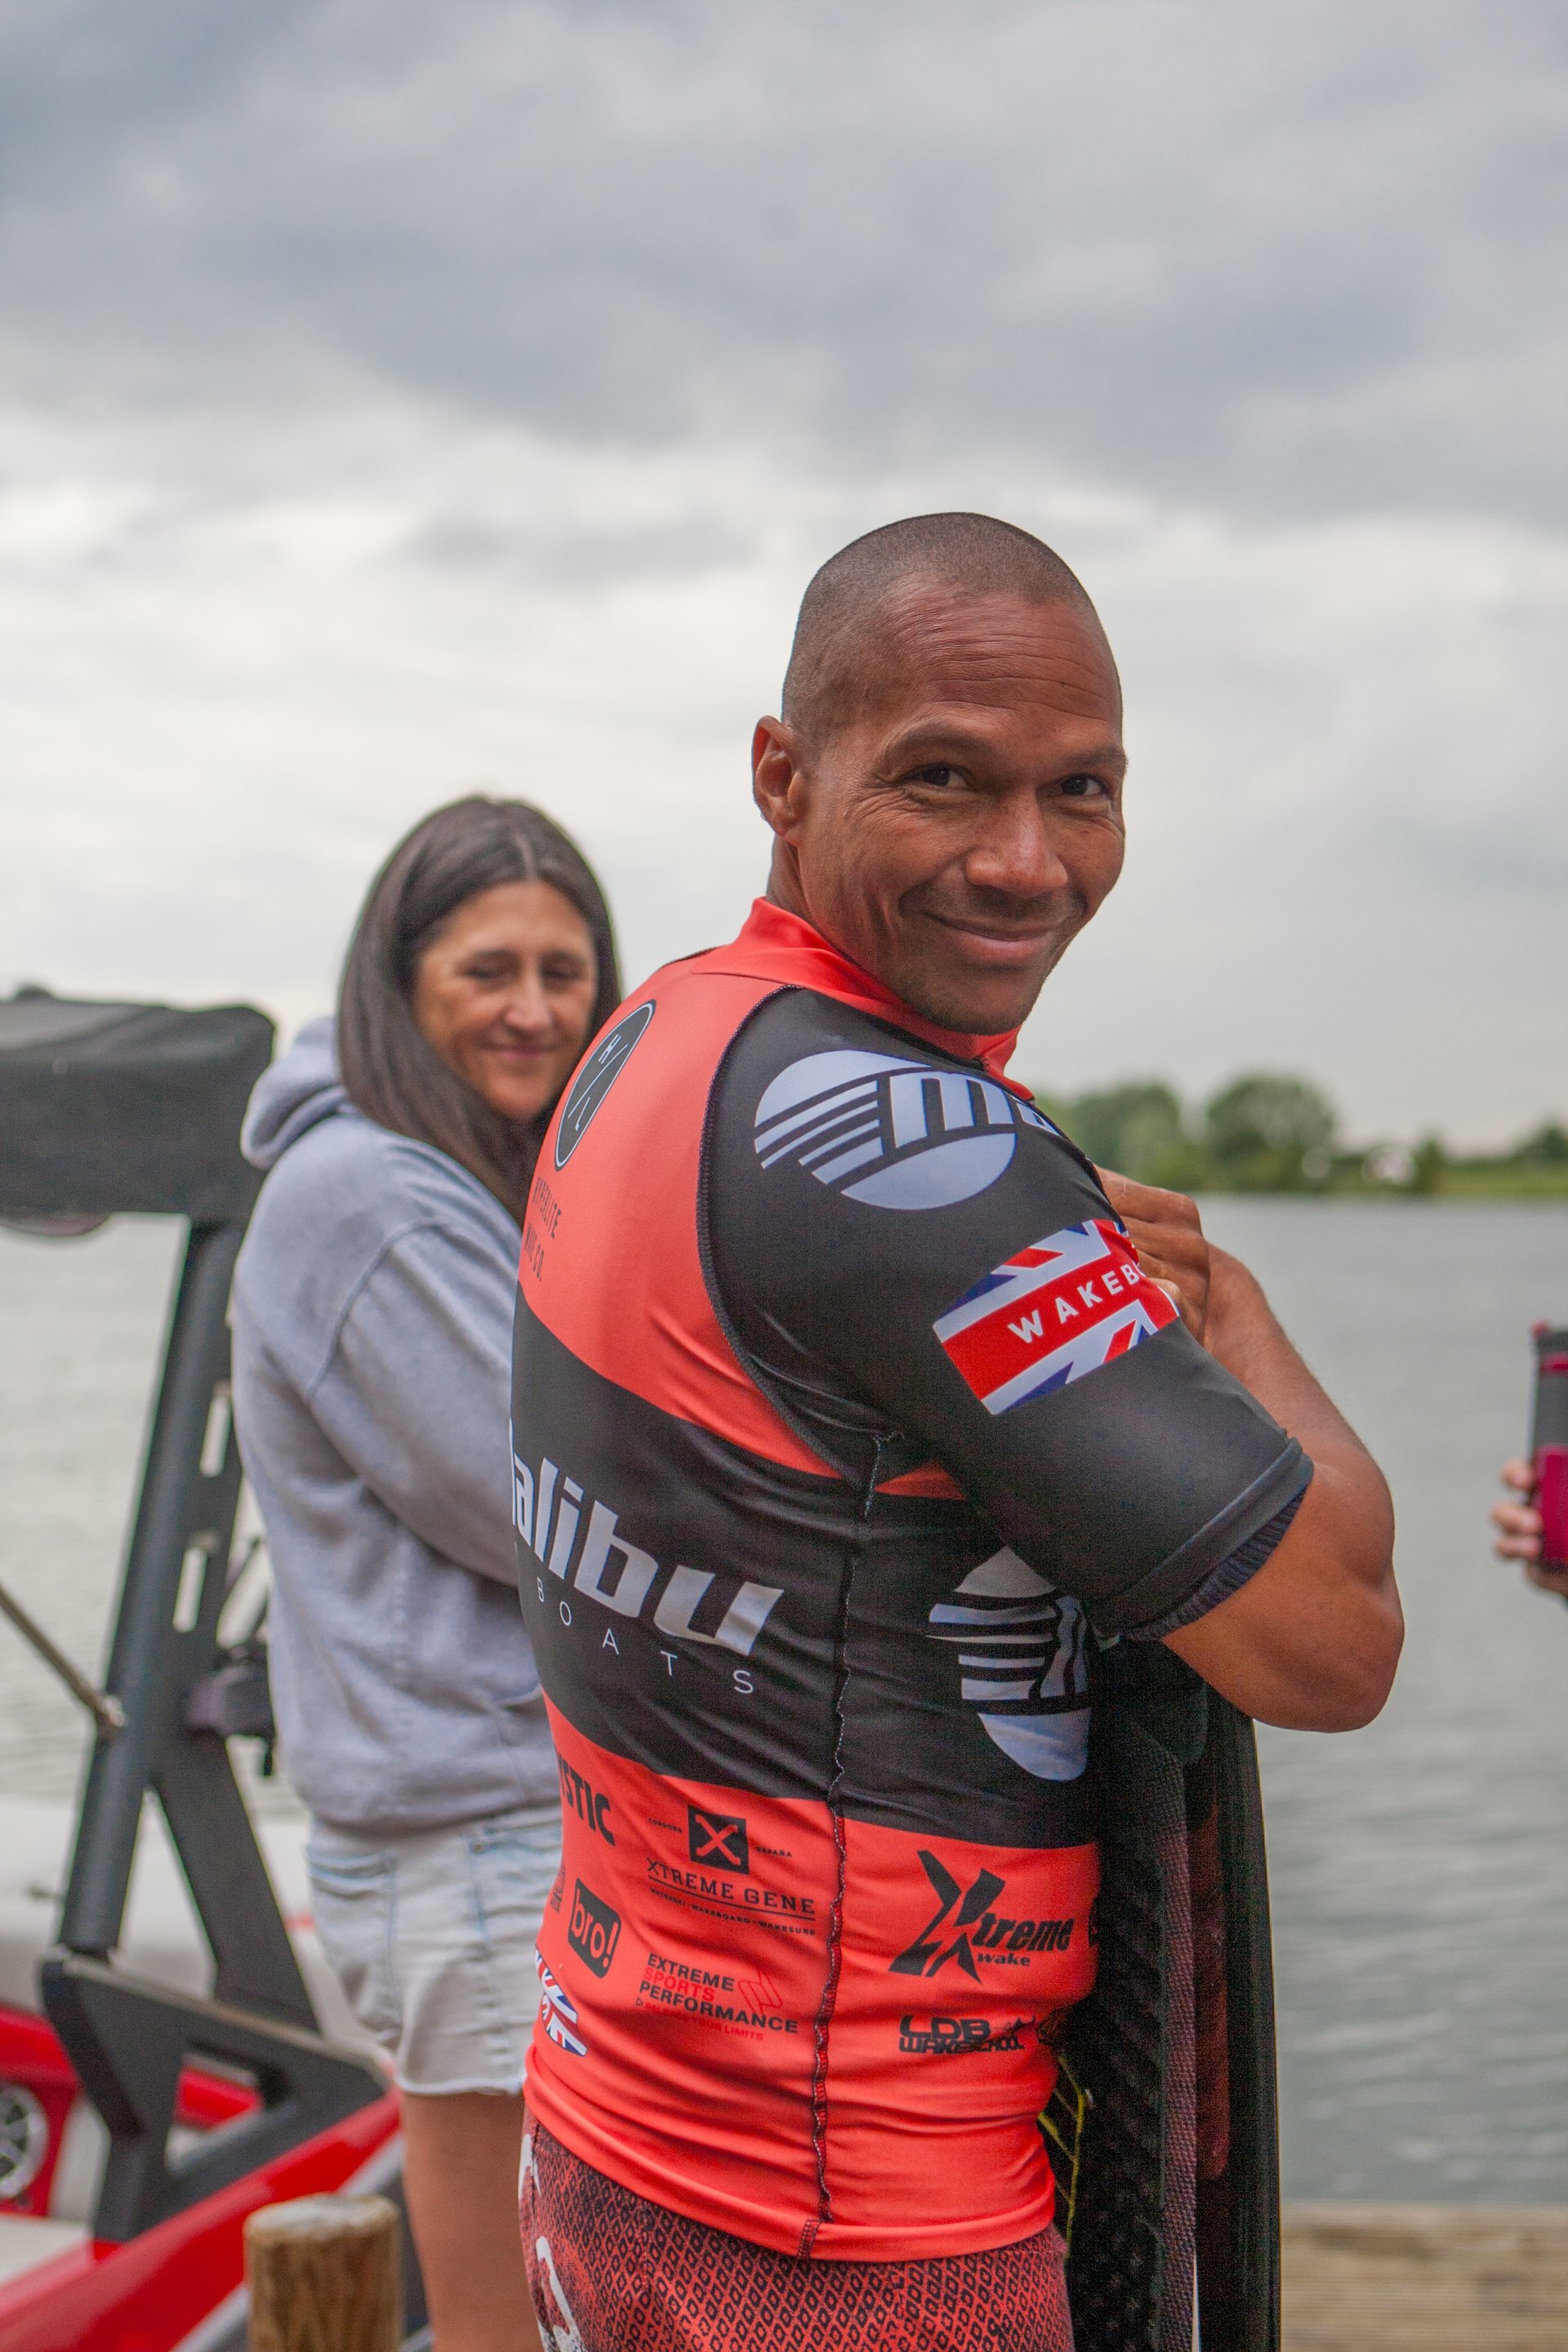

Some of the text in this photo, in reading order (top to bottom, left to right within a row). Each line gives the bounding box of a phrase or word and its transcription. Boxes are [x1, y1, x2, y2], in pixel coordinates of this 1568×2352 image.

[532, 1177, 561, 1239] HYPERLITE
[1008, 1263, 1145, 1343] WAKEB
[510, 1418, 784, 1656] alibu
[537, 1577, 754, 1694] BOATS
[647, 1856, 816, 1916] XTREME GENE
[571, 1888, 618, 1968] bro!
[692, 1904, 750, 1924] WAKEBOARD
[644, 1967, 715, 2002] SPORTS
[647, 1953, 735, 1992] EXTREME
[978, 1953, 1031, 1967] wake
[639, 1980, 798, 2034] PERFORMANCE
[724, 2025, 764, 2041] LIMITS
[899, 2015, 991, 2041] LDB
